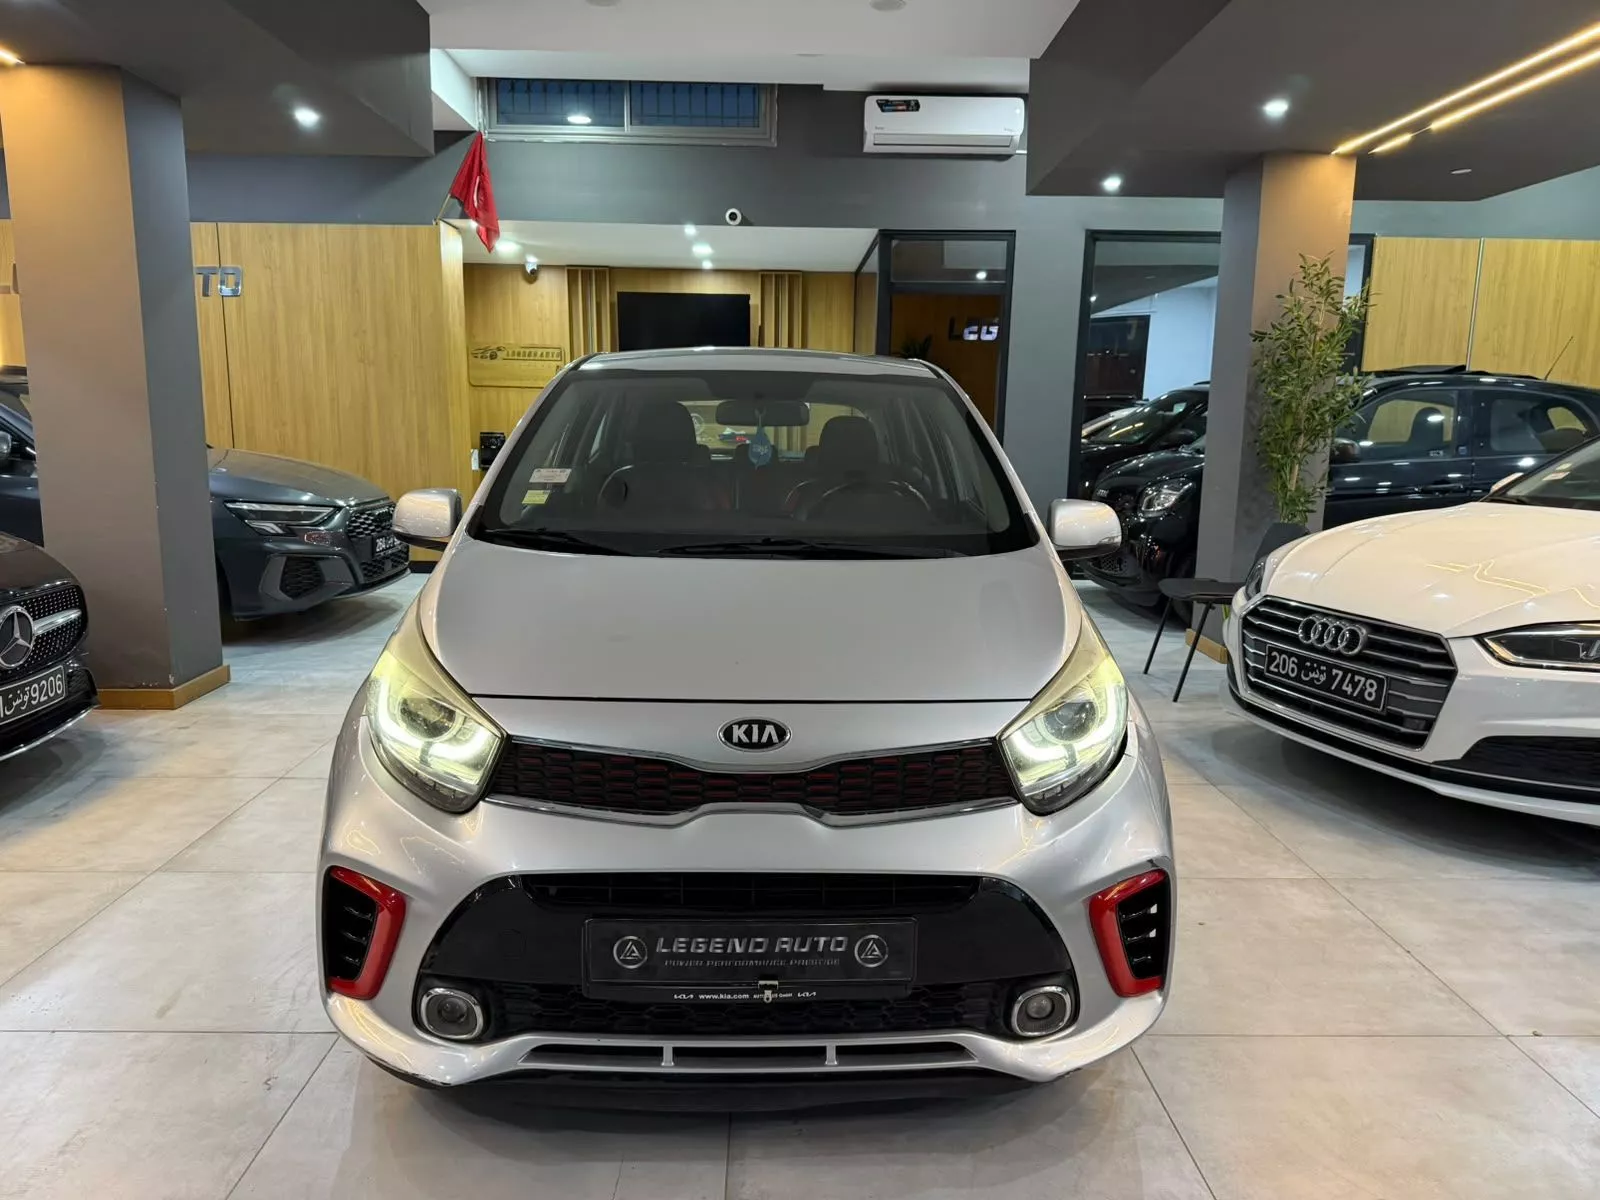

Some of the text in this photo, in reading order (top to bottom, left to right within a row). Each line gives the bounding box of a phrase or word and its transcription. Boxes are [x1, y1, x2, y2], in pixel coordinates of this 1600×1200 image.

[1269, 651, 1298, 678] 206
[1331, 668, 1378, 701] 7478
[30, 673, 63, 705] 9206
[732, 724, 779, 743] KIA
[656, 936, 848, 953] LEGEND AUTO
[698, 992, 749, 1000] www.kia.com
